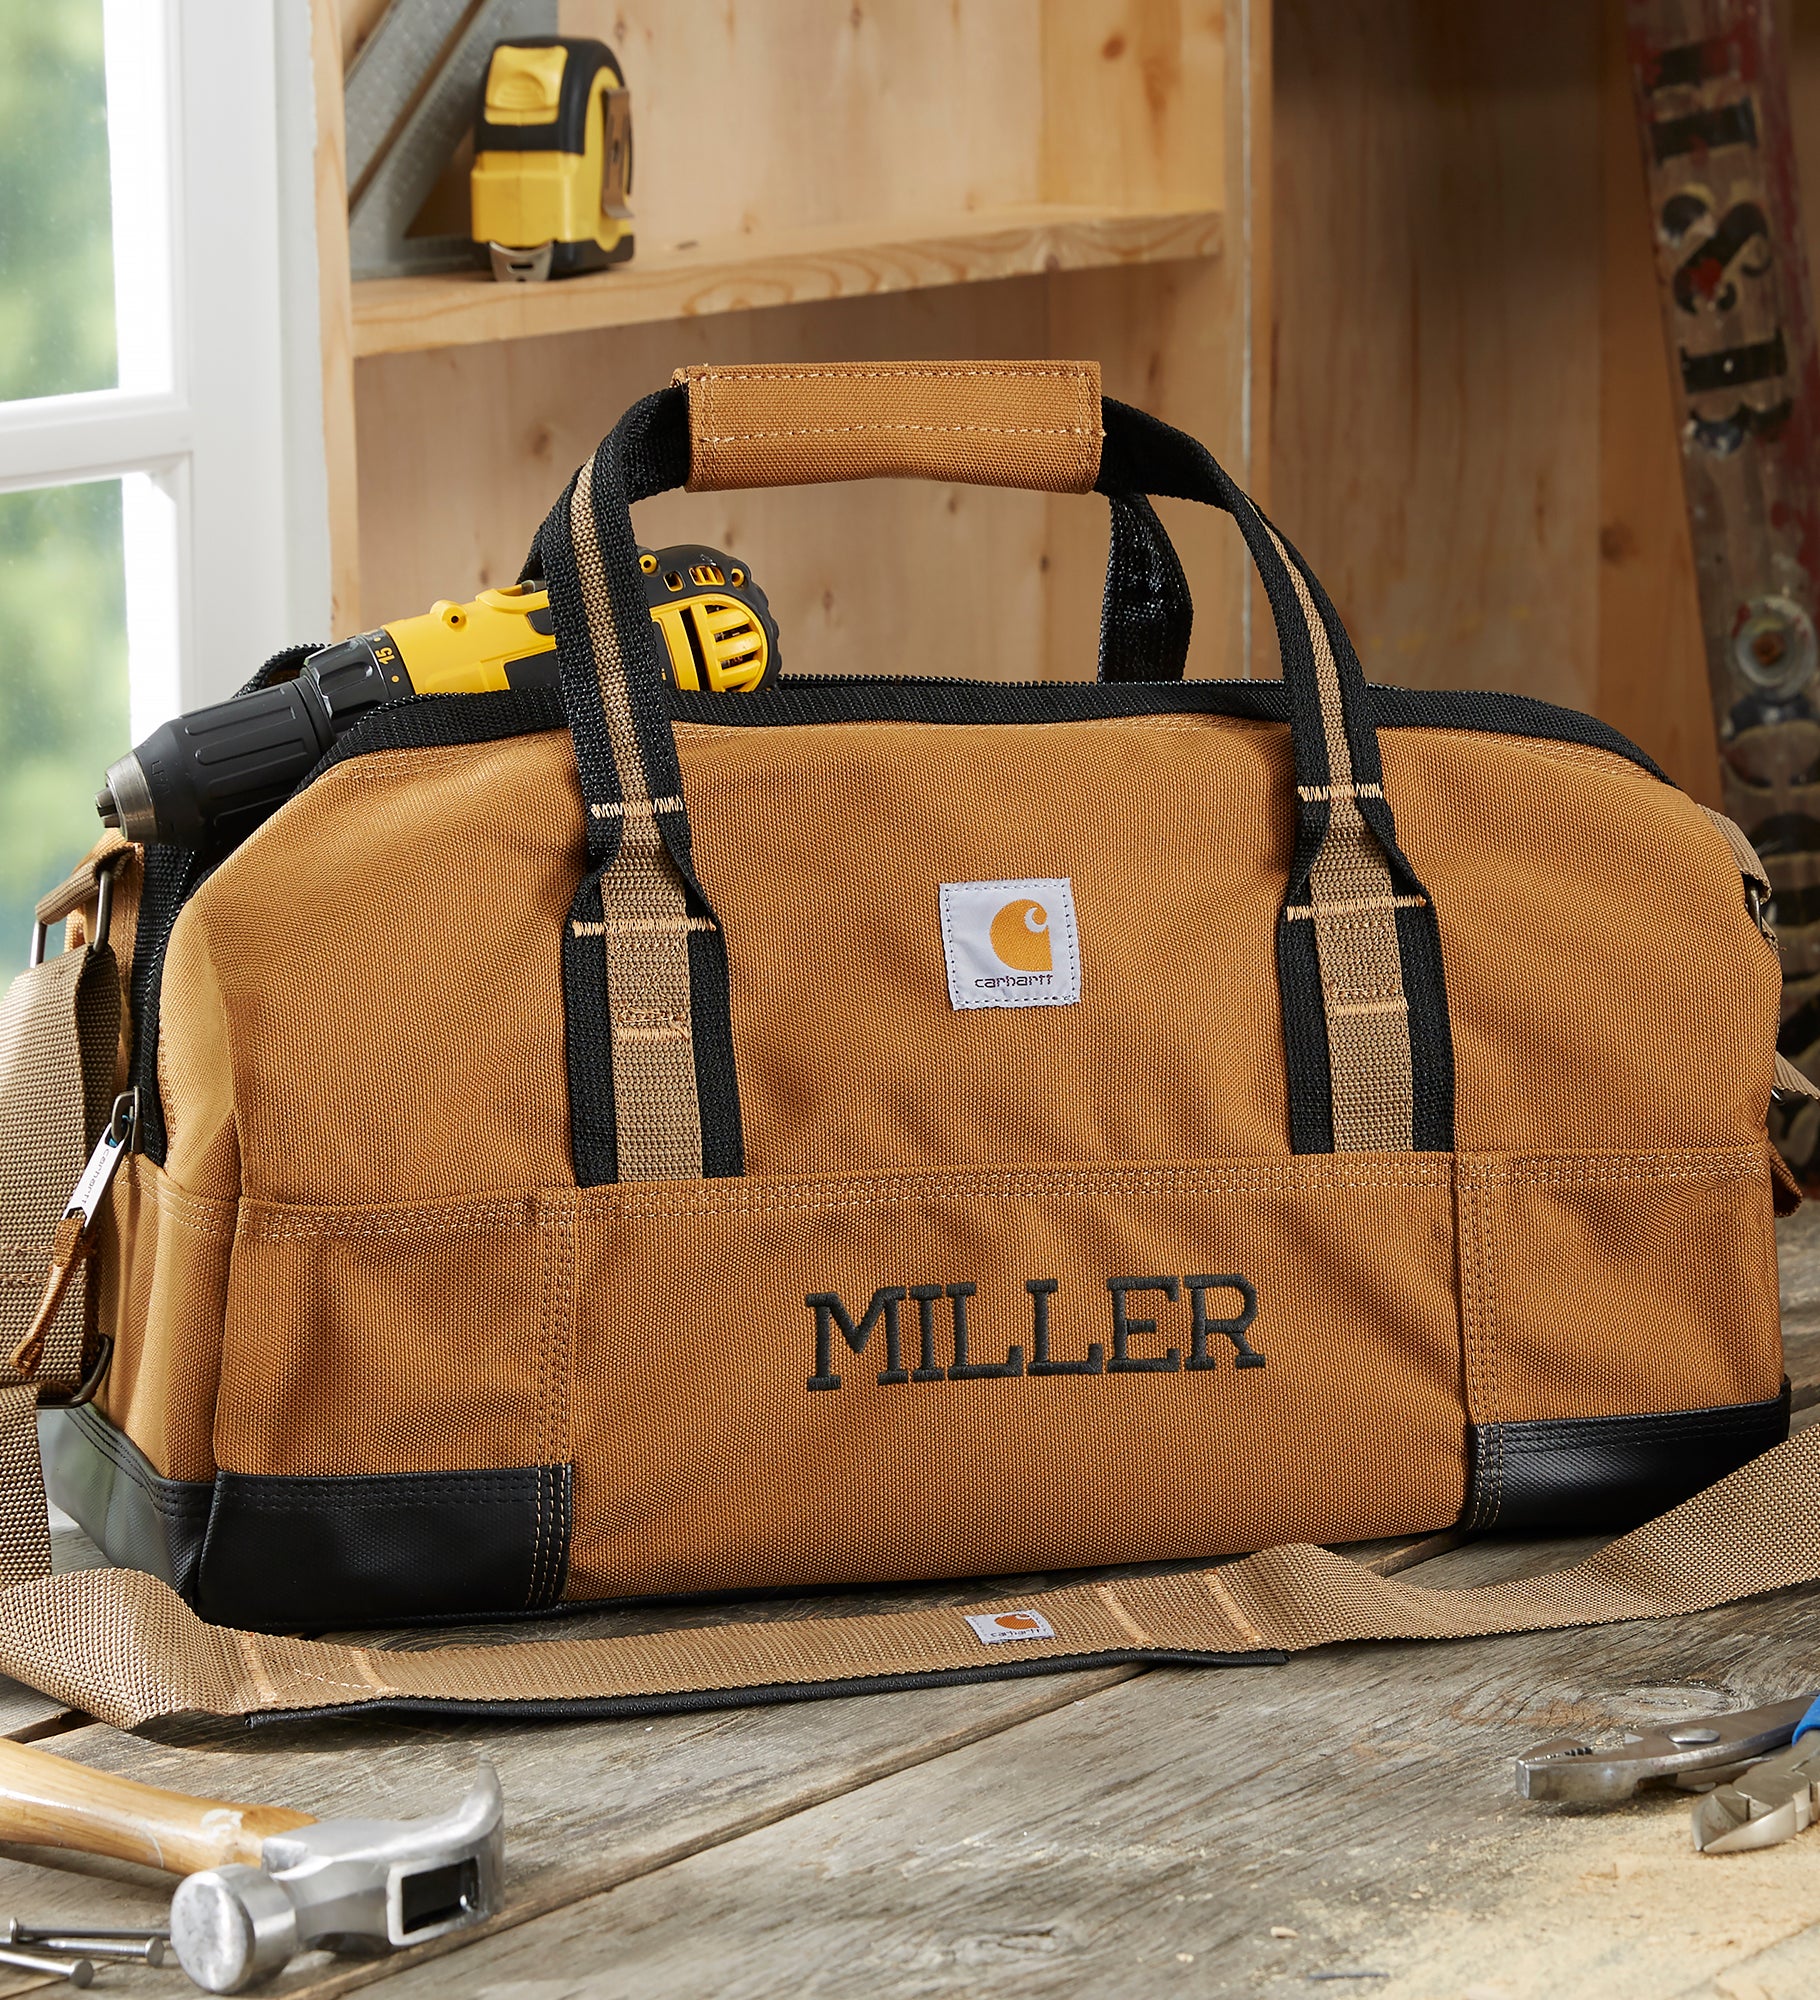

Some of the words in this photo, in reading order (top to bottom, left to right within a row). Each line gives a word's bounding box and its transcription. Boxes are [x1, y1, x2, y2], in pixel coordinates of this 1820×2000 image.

[374, 647, 396, 665] 15
[974, 973, 1054, 989] carhartt
[804, 1274, 1267, 1392] MILLER
